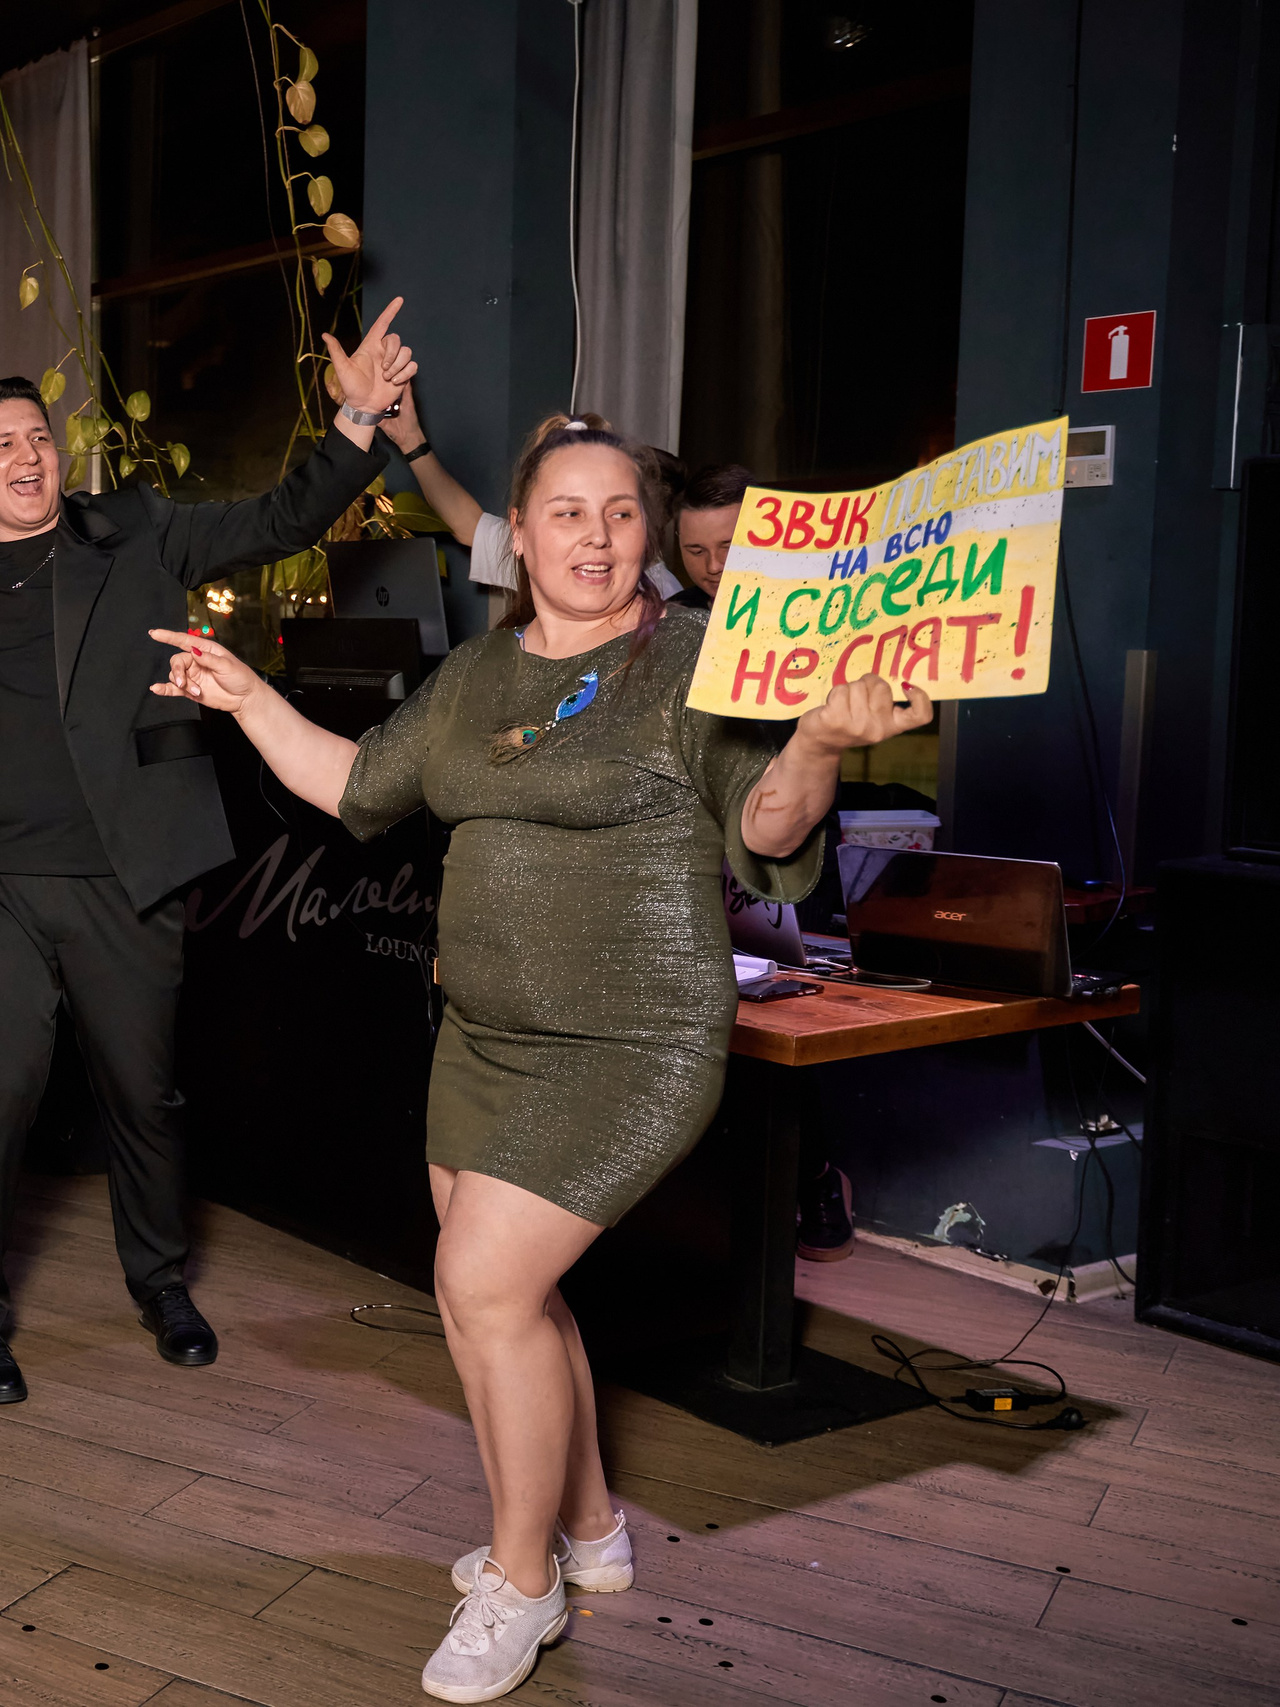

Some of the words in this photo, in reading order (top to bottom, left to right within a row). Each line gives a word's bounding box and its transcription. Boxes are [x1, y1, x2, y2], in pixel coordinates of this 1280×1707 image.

[747, 492, 877, 549] ЗВУК
[879, 426, 1062, 535] ПОСТАВИМ
[828, 545, 869, 580] НА
[883, 511, 952, 564] ВСЮ
[725, 584, 761, 637] И
[934, 910, 967, 921] acer
[365, 932, 438, 966] LOUNG
